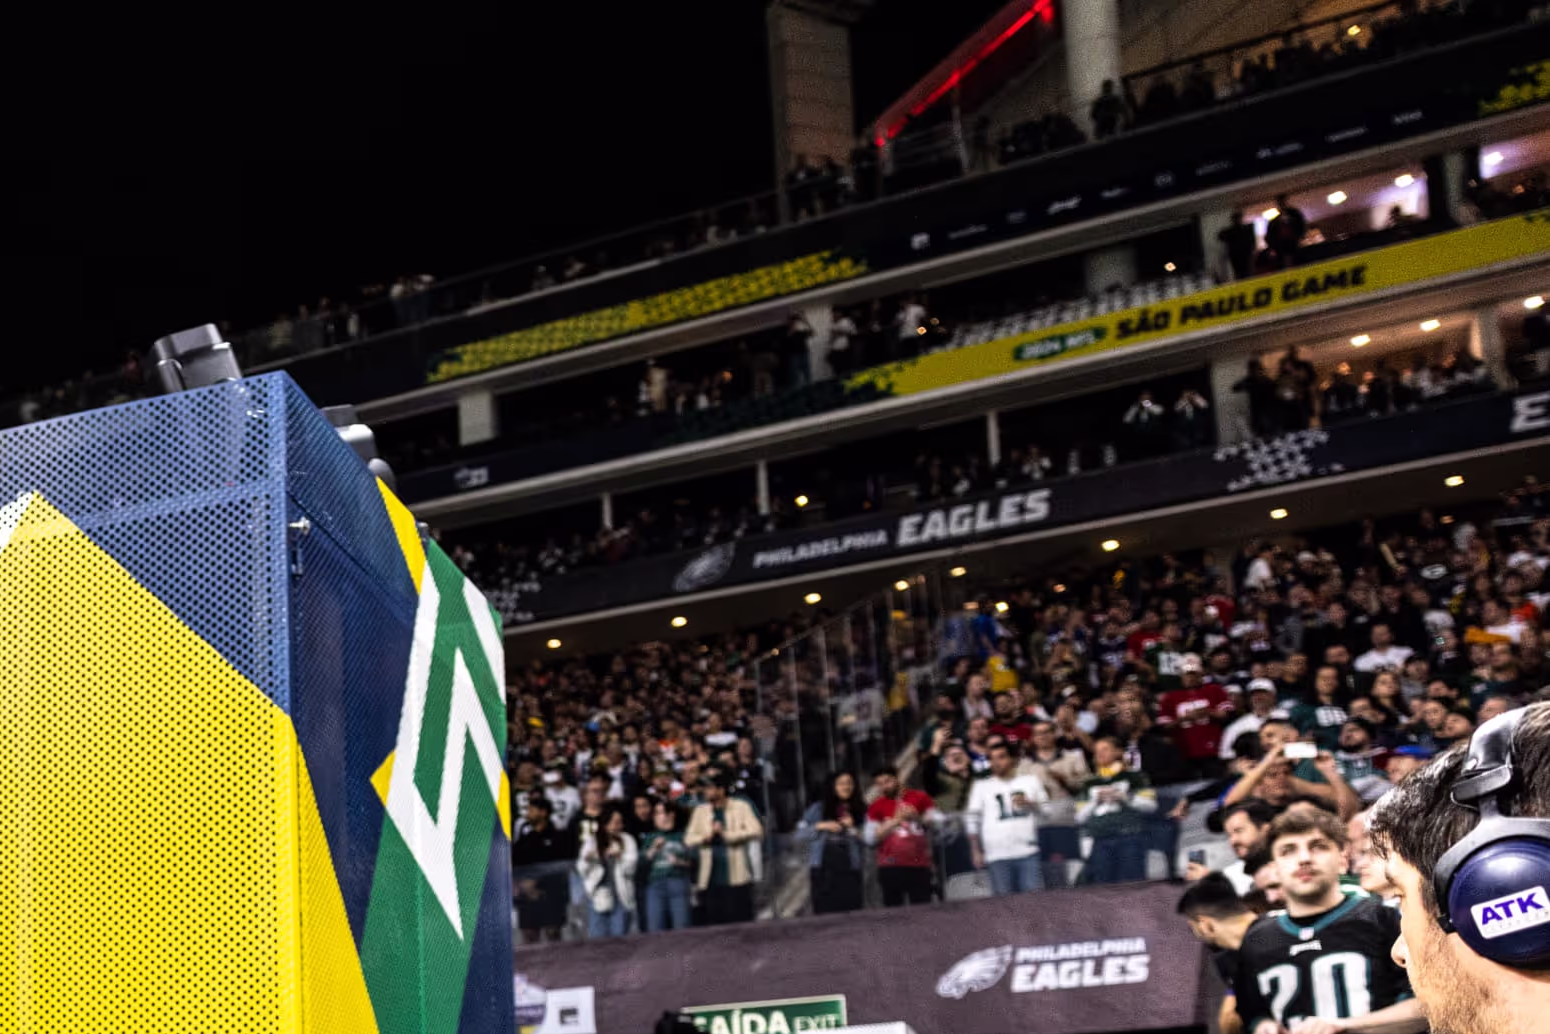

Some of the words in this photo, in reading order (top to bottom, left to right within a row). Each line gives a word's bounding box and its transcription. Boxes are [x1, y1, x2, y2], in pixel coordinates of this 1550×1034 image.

[1179, 286, 1273, 325] PAULO
[1281, 265, 1367, 302] GAME
[752, 529, 889, 568] PHILADELPHIA
[896, 489, 1052, 546] EAGLES
[1482, 892, 1544, 925] ATK
[1010, 953, 1150, 992] EAGLES
[1014, 937, 1147, 963] PHILADELPHIA
[1257, 952, 1371, 1024] 20
